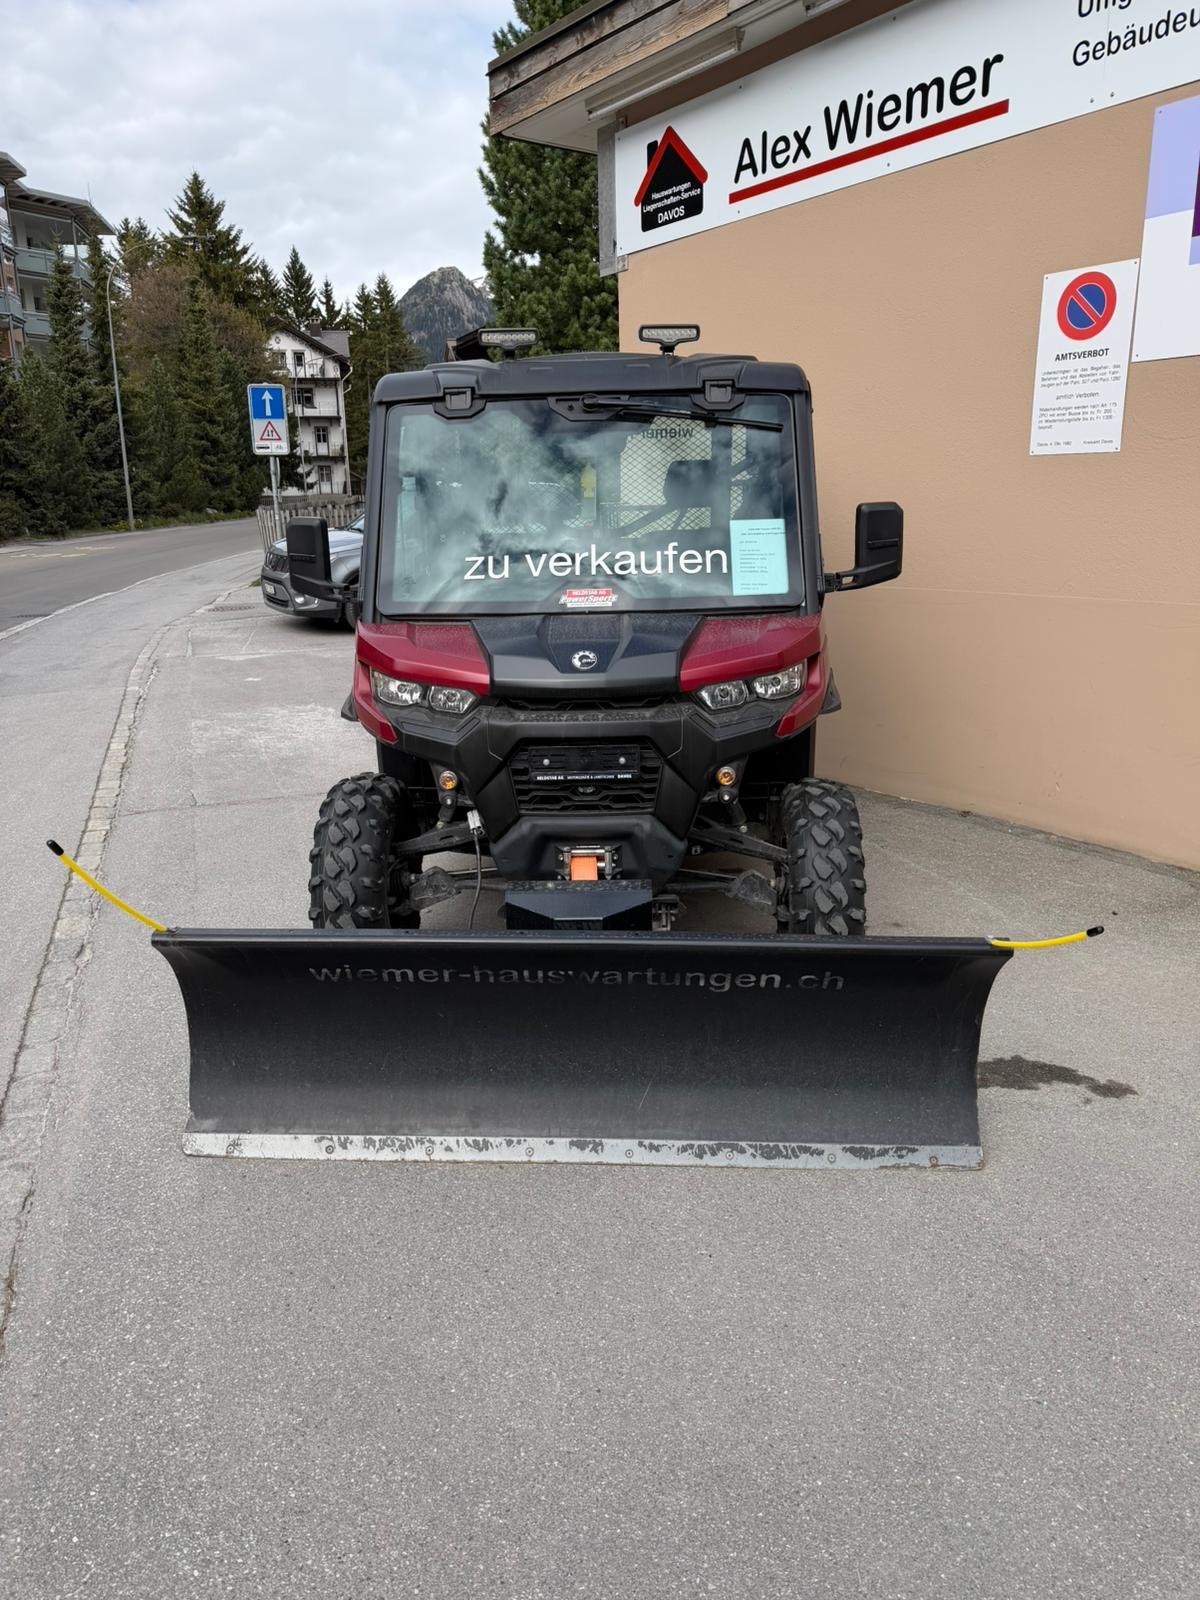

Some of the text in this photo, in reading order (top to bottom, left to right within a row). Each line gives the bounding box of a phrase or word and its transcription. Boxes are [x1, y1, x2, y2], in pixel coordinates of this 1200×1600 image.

[734, 53, 1004, 184] Alex Wiemer
[643, 188, 701, 213] Liegenschaften-Service
[652, 182, 692, 200] Hauswartungen
[658, 206, 685, 223] DAVOS
[1054, 348, 1109, 362] AMTSVERBOT
[464, 556, 509, 580] zu
[525, 542, 728, 577] verkaufen
[309, 964, 845, 993] wiemer-hauswartungen.ch
